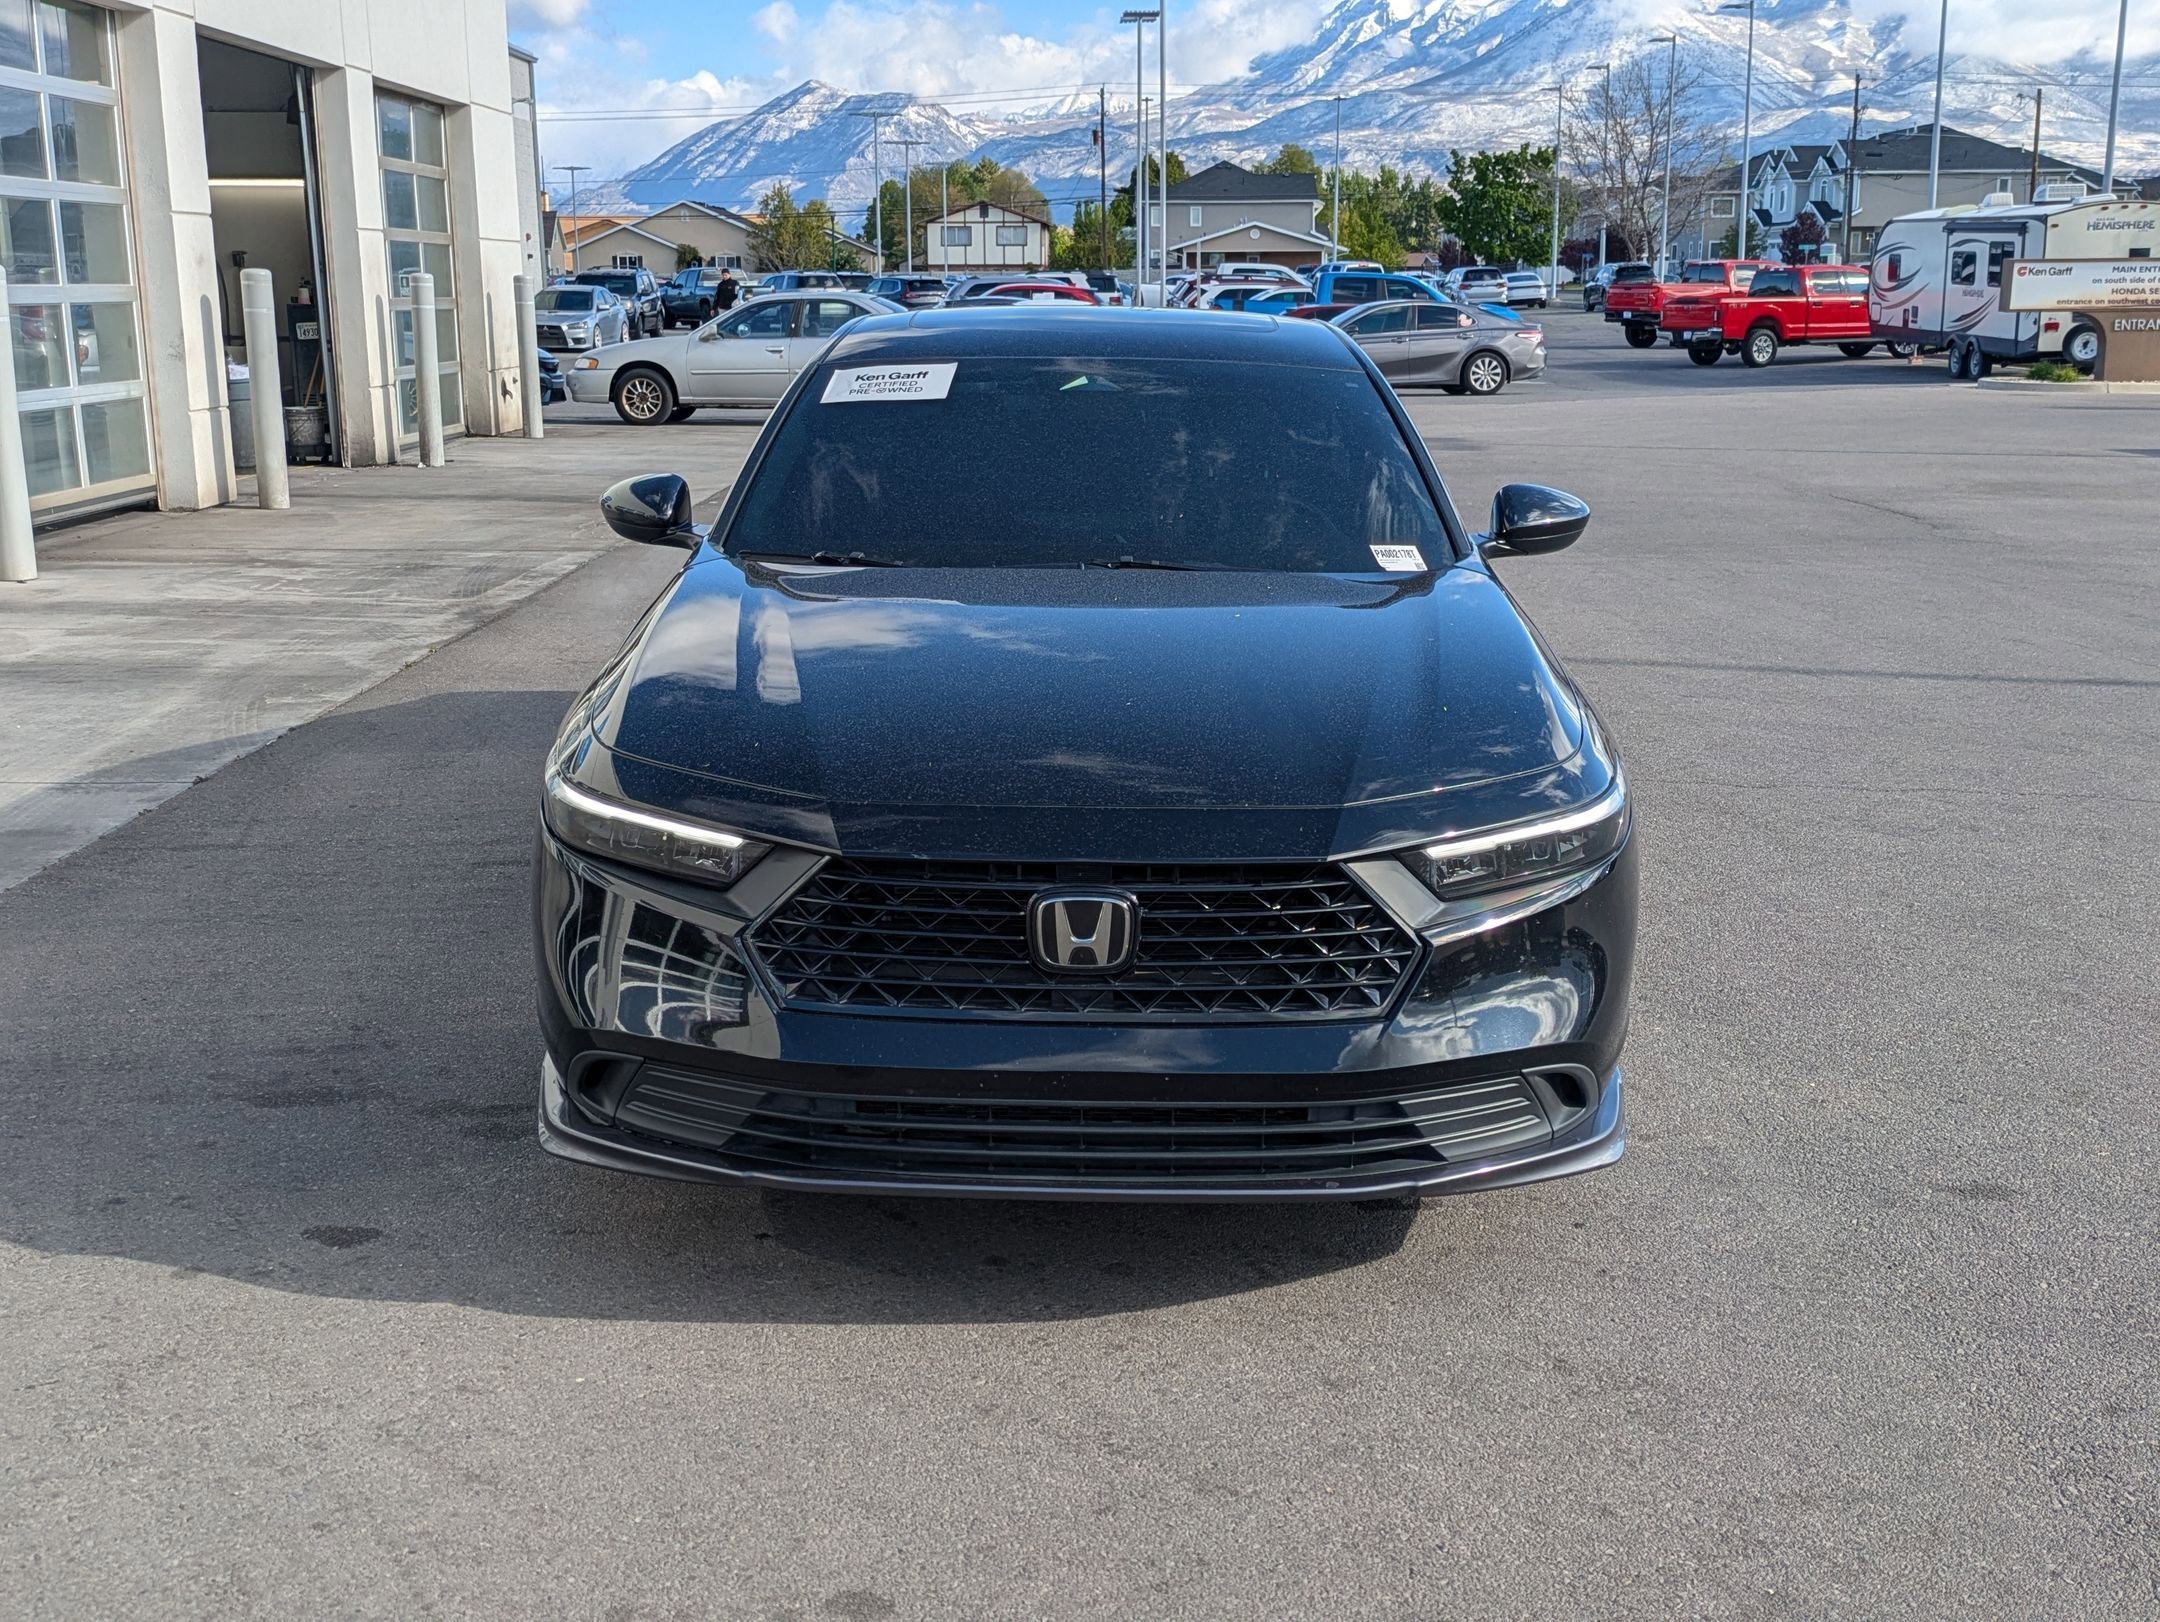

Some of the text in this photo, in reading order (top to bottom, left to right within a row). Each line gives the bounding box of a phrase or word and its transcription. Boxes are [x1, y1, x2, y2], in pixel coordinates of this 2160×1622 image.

[2087, 220, 2156, 231] HEMISPHERE
[2028, 266, 2073, 276] Ken Garff
[2105, 276, 2127, 284] south
[2107, 297, 2149, 305] southwest
[855, 371, 929, 382] Ken Garff
[849, 387, 923, 395] PRE-OWNED
